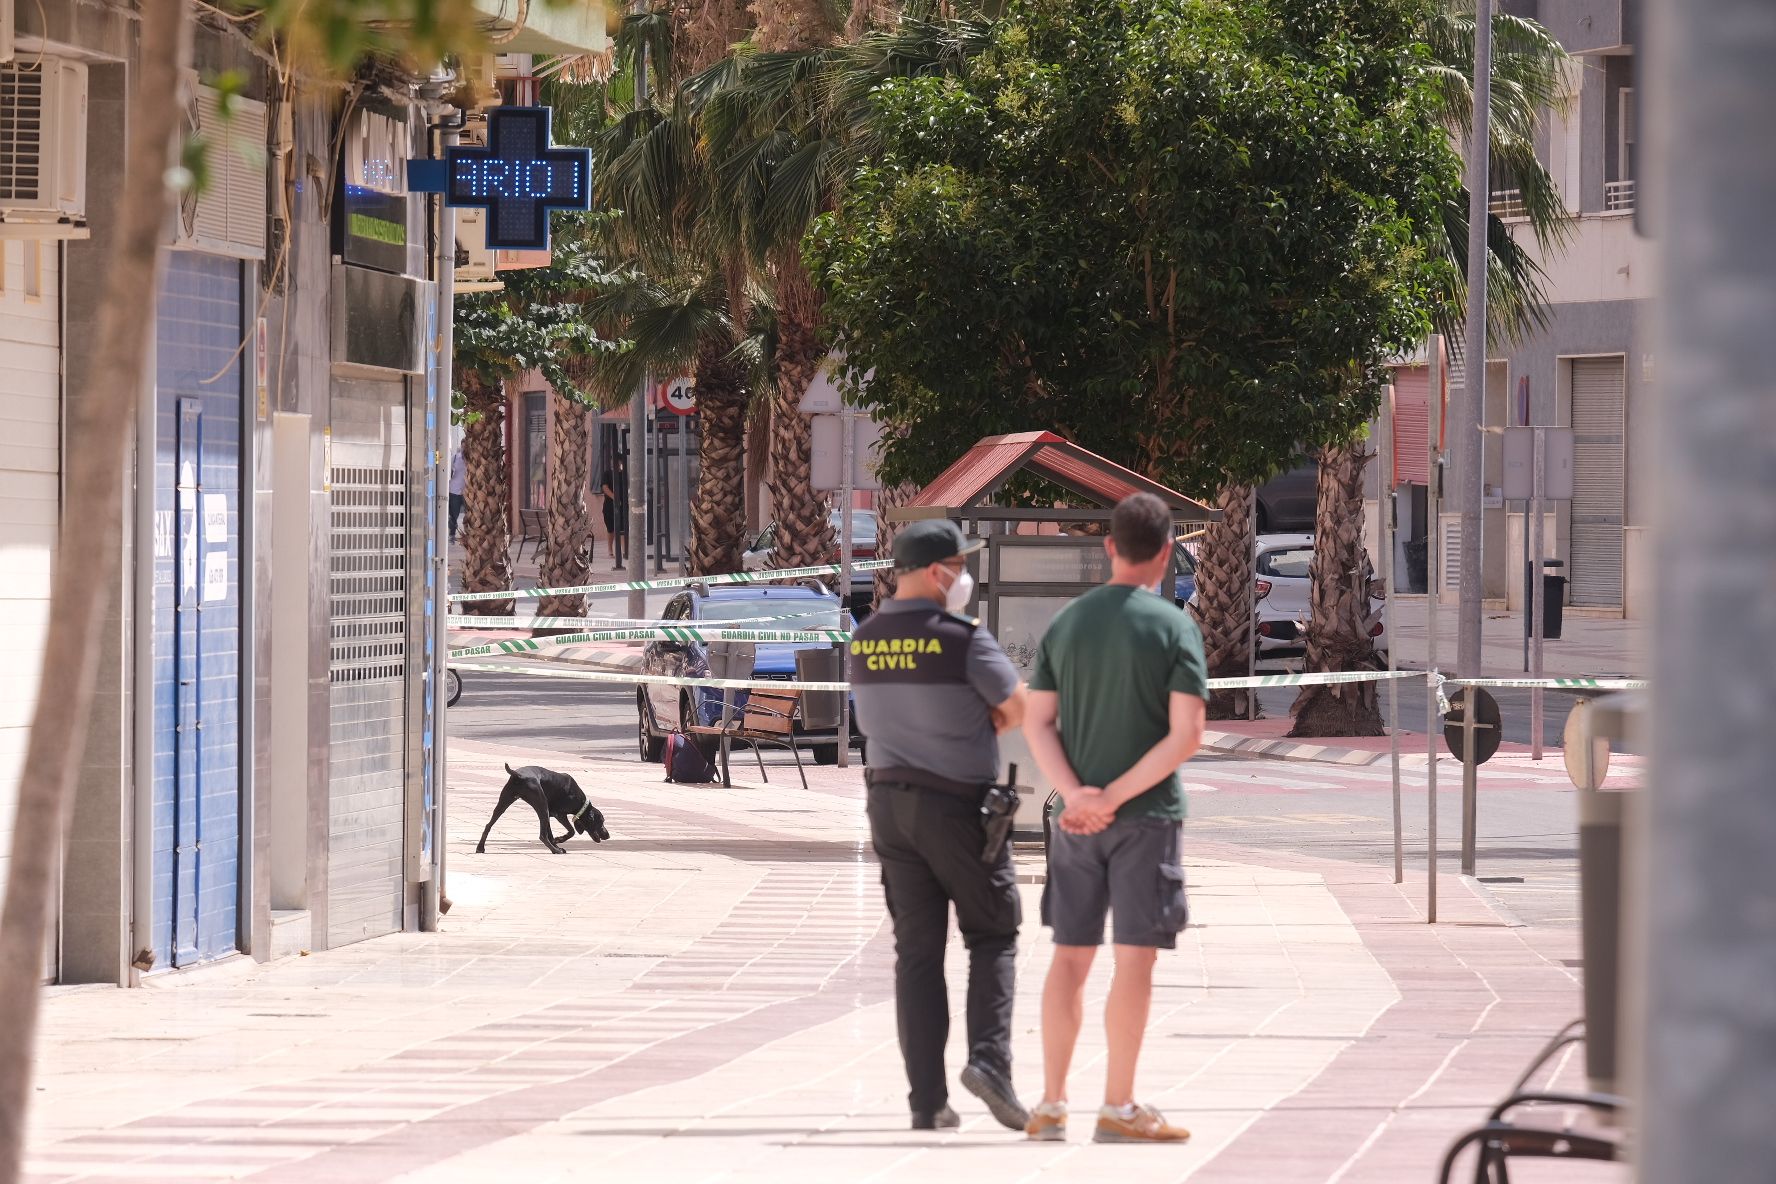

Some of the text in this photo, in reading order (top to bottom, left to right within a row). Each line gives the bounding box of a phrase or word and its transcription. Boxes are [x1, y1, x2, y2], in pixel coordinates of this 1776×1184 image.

[555, 630, 656, 645] GUARDIA CIVIL NO PASAR
[721, 630, 820, 642] GUARDIA CIVIL NO PASAR
[451, 645, 491, 658] NO PASAR
[850, 637, 943, 655] GUARDIA
[866, 654, 917, 670] CIVIL
